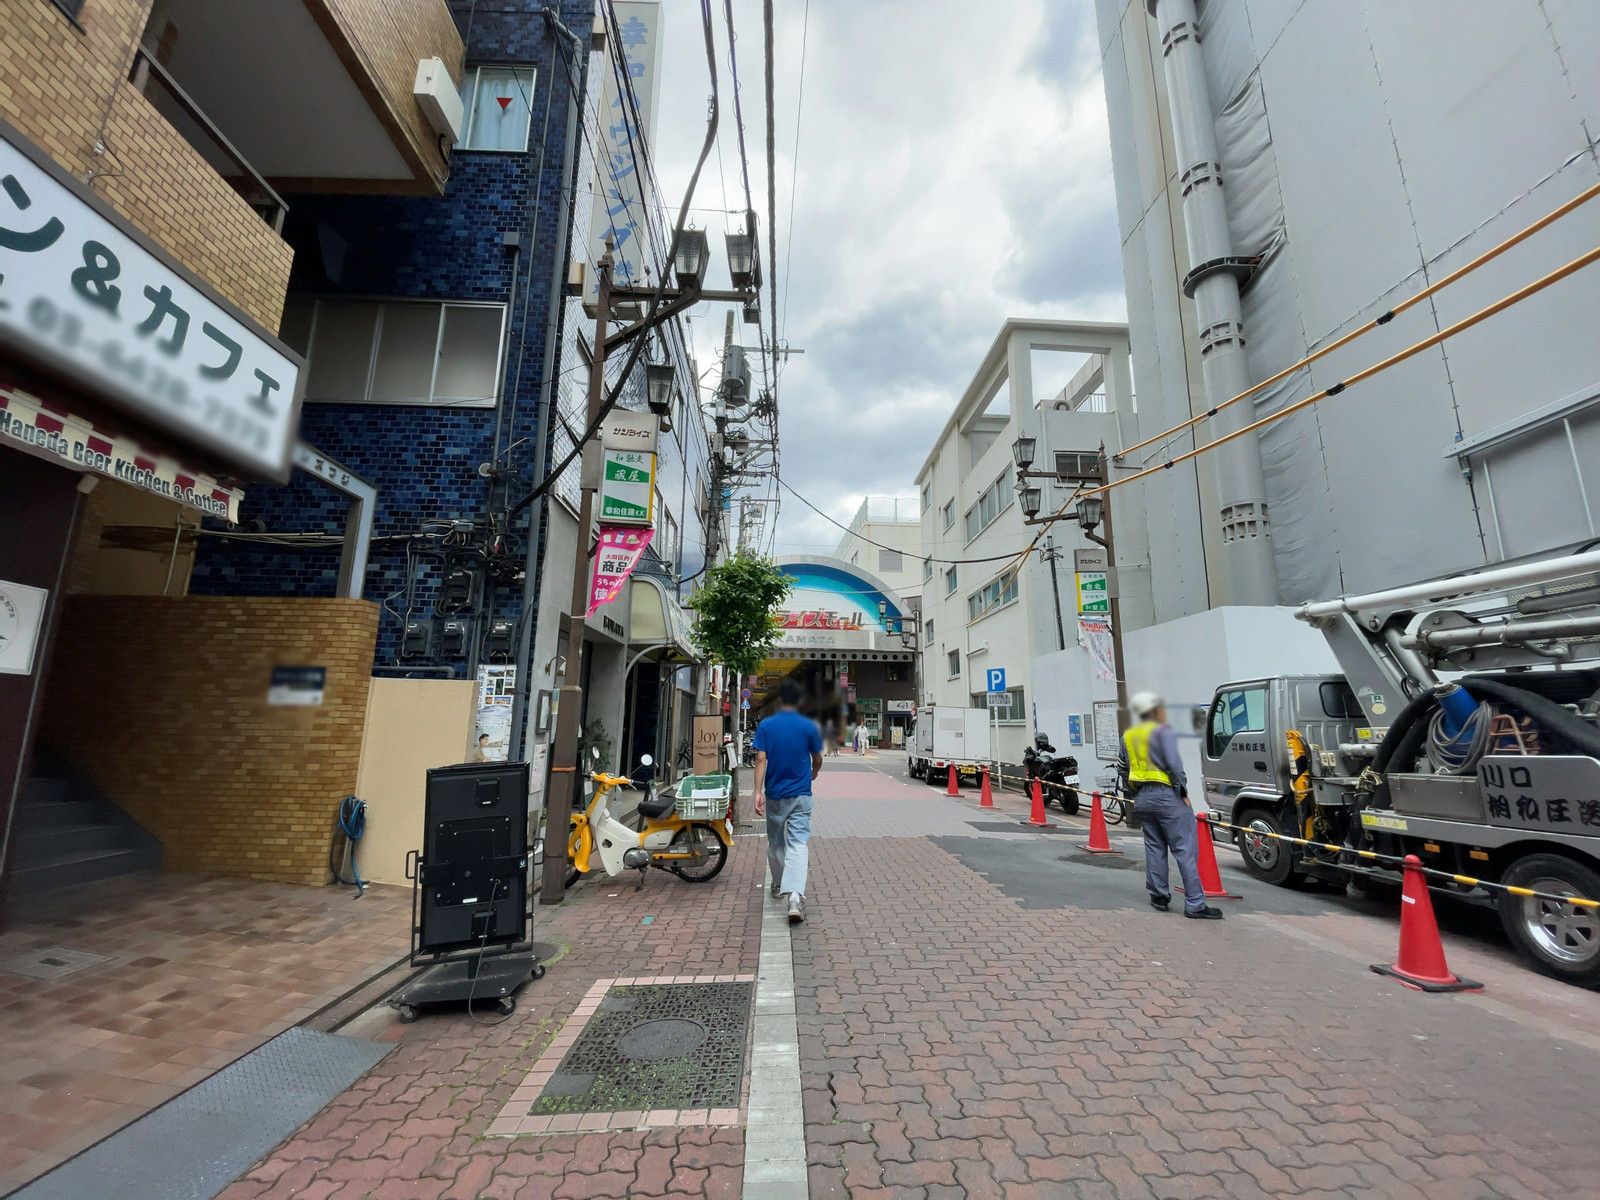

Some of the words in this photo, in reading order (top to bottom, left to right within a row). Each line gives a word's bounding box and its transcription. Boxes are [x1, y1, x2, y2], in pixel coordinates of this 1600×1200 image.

[613, 428, 651, 438] サンライズ
[0, 409, 68, 456] Haneda
[73, 441, 112, 473] Beer
[115, 458, 170, 495] Kitchen
[173, 485, 184, 500] &
[186, 487, 226, 517] Coffee
[991, 670, 1002, 690] P
[1481, 764, 1532, 789] 川口
